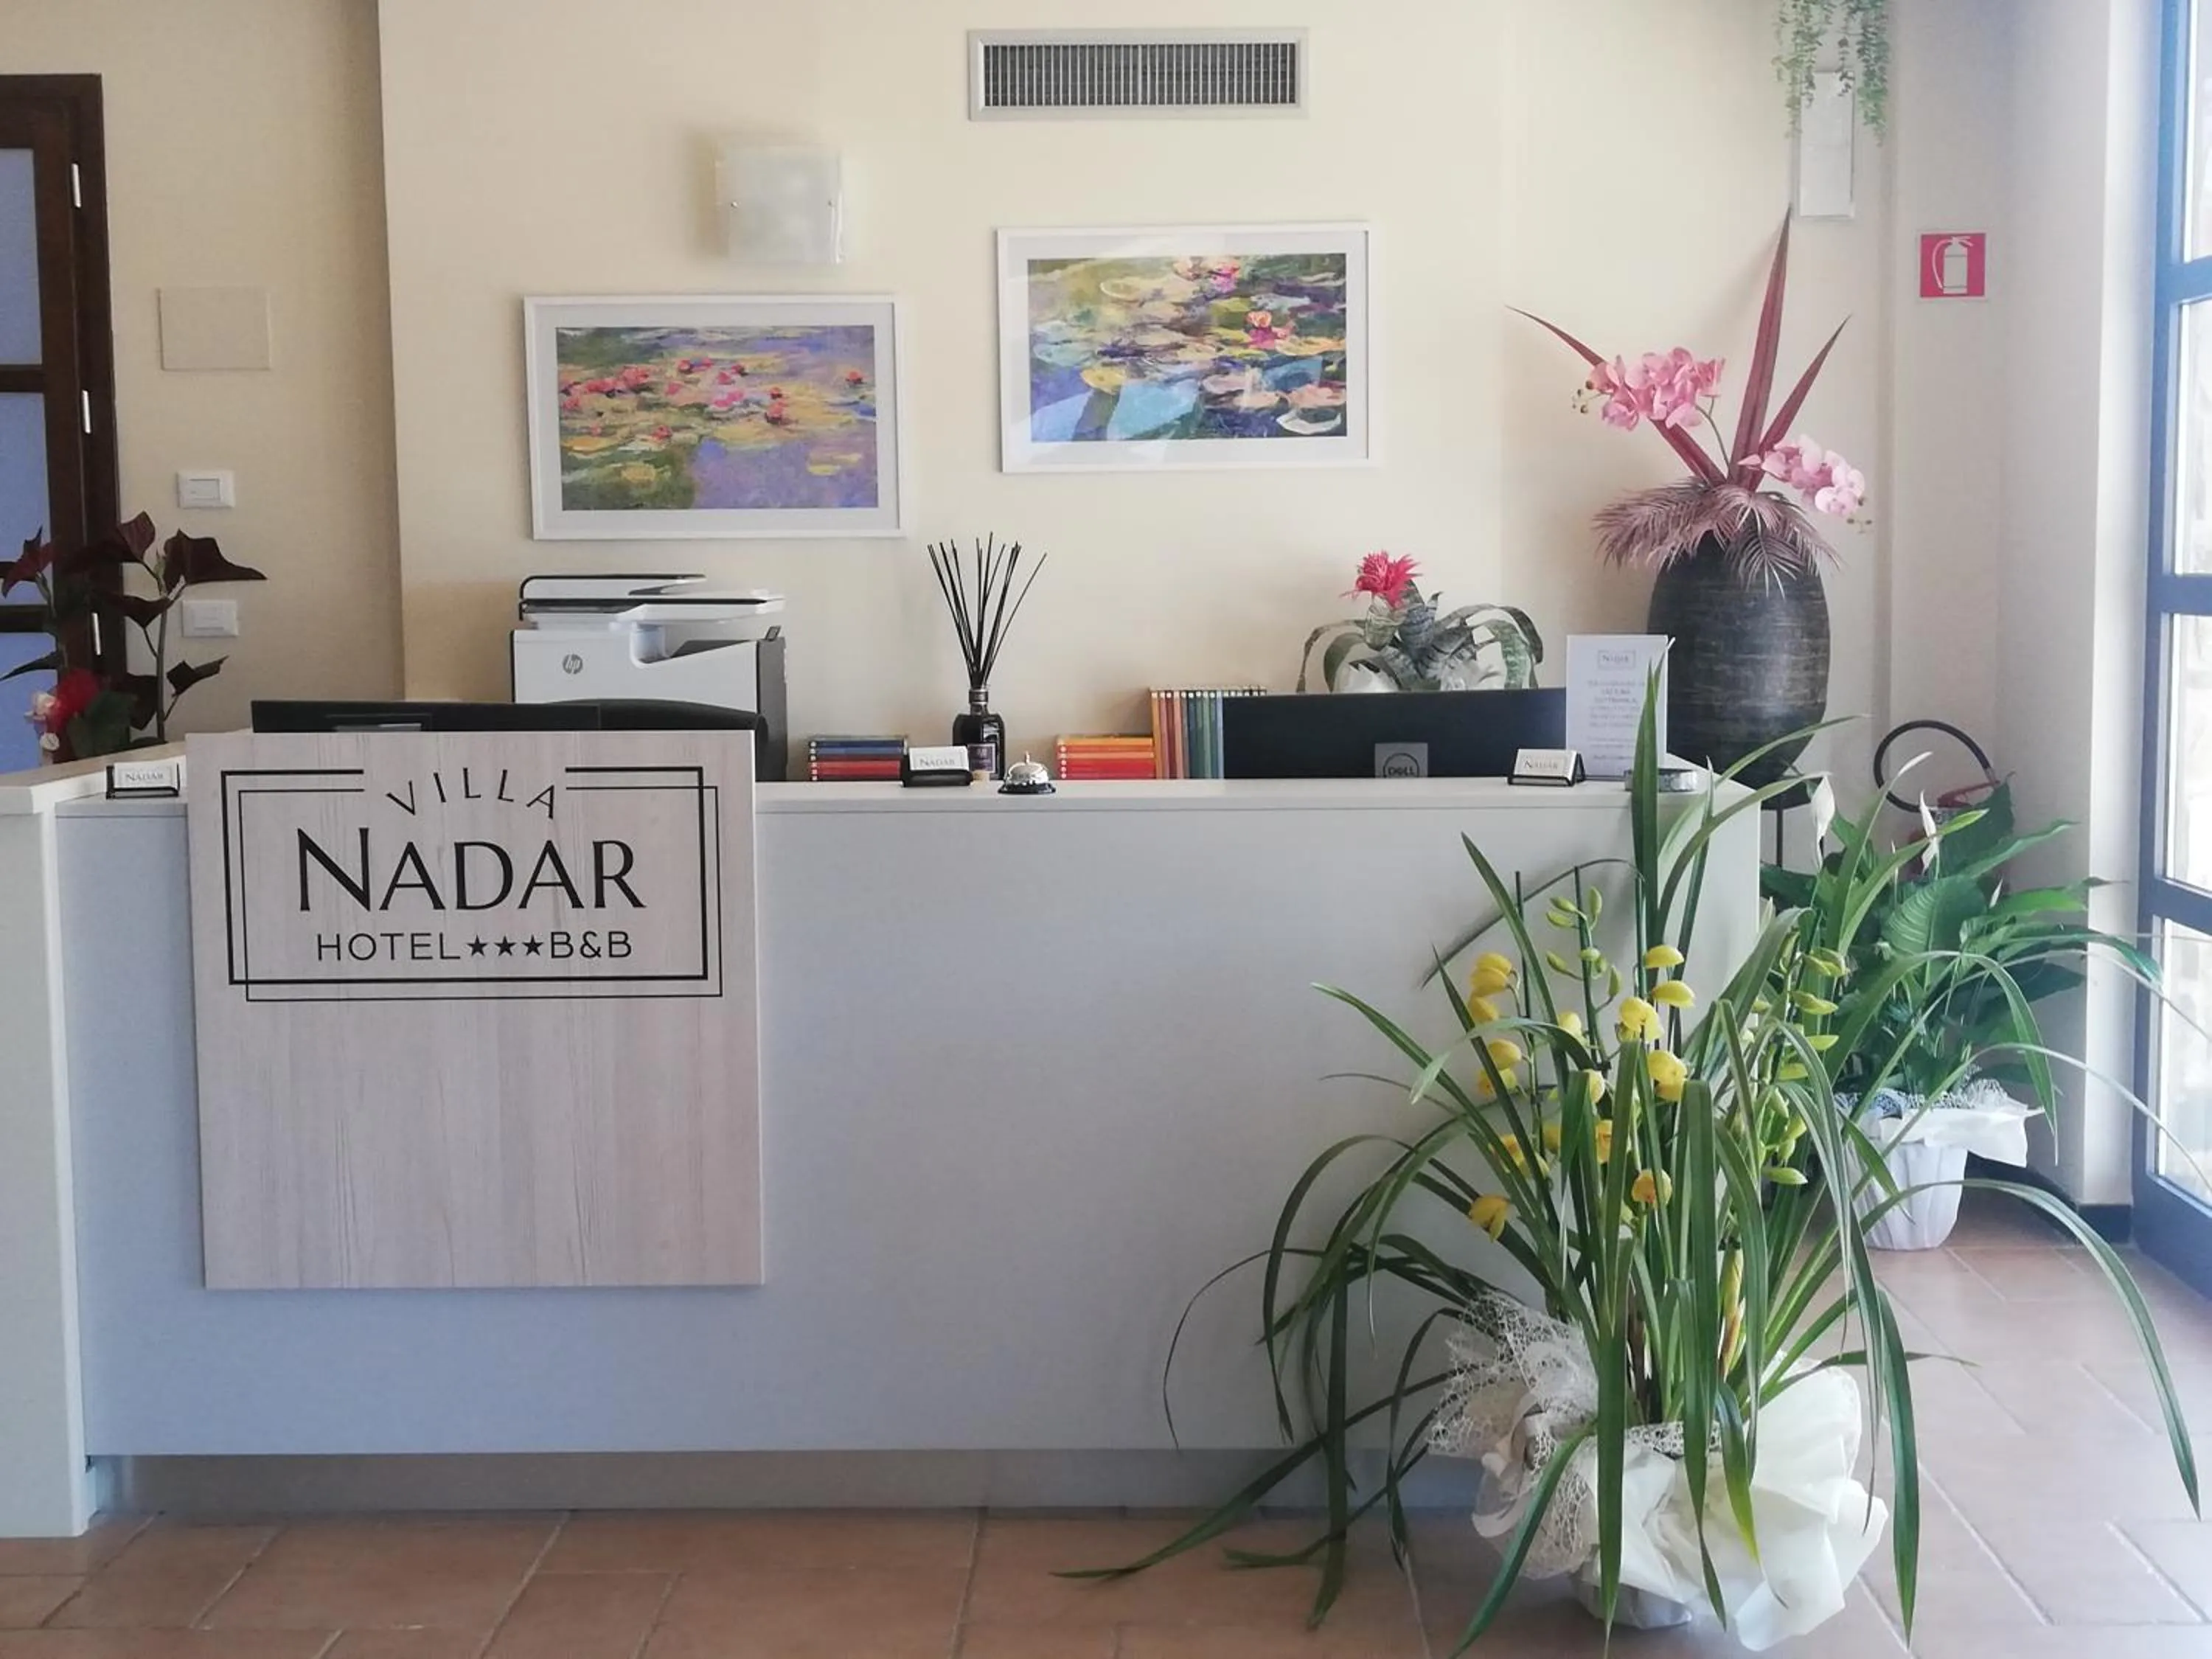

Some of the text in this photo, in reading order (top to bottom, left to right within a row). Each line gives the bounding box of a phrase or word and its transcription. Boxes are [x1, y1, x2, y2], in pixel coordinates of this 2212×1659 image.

[563, 654, 582, 674] hp
[919, 758, 956, 768] NADAR
[1388, 766, 1416, 776] DELL
[386, 767, 555, 819] VILLA
[296, 827, 647, 912] NADAR
[316, 930, 633, 961] HOTEL B&B
